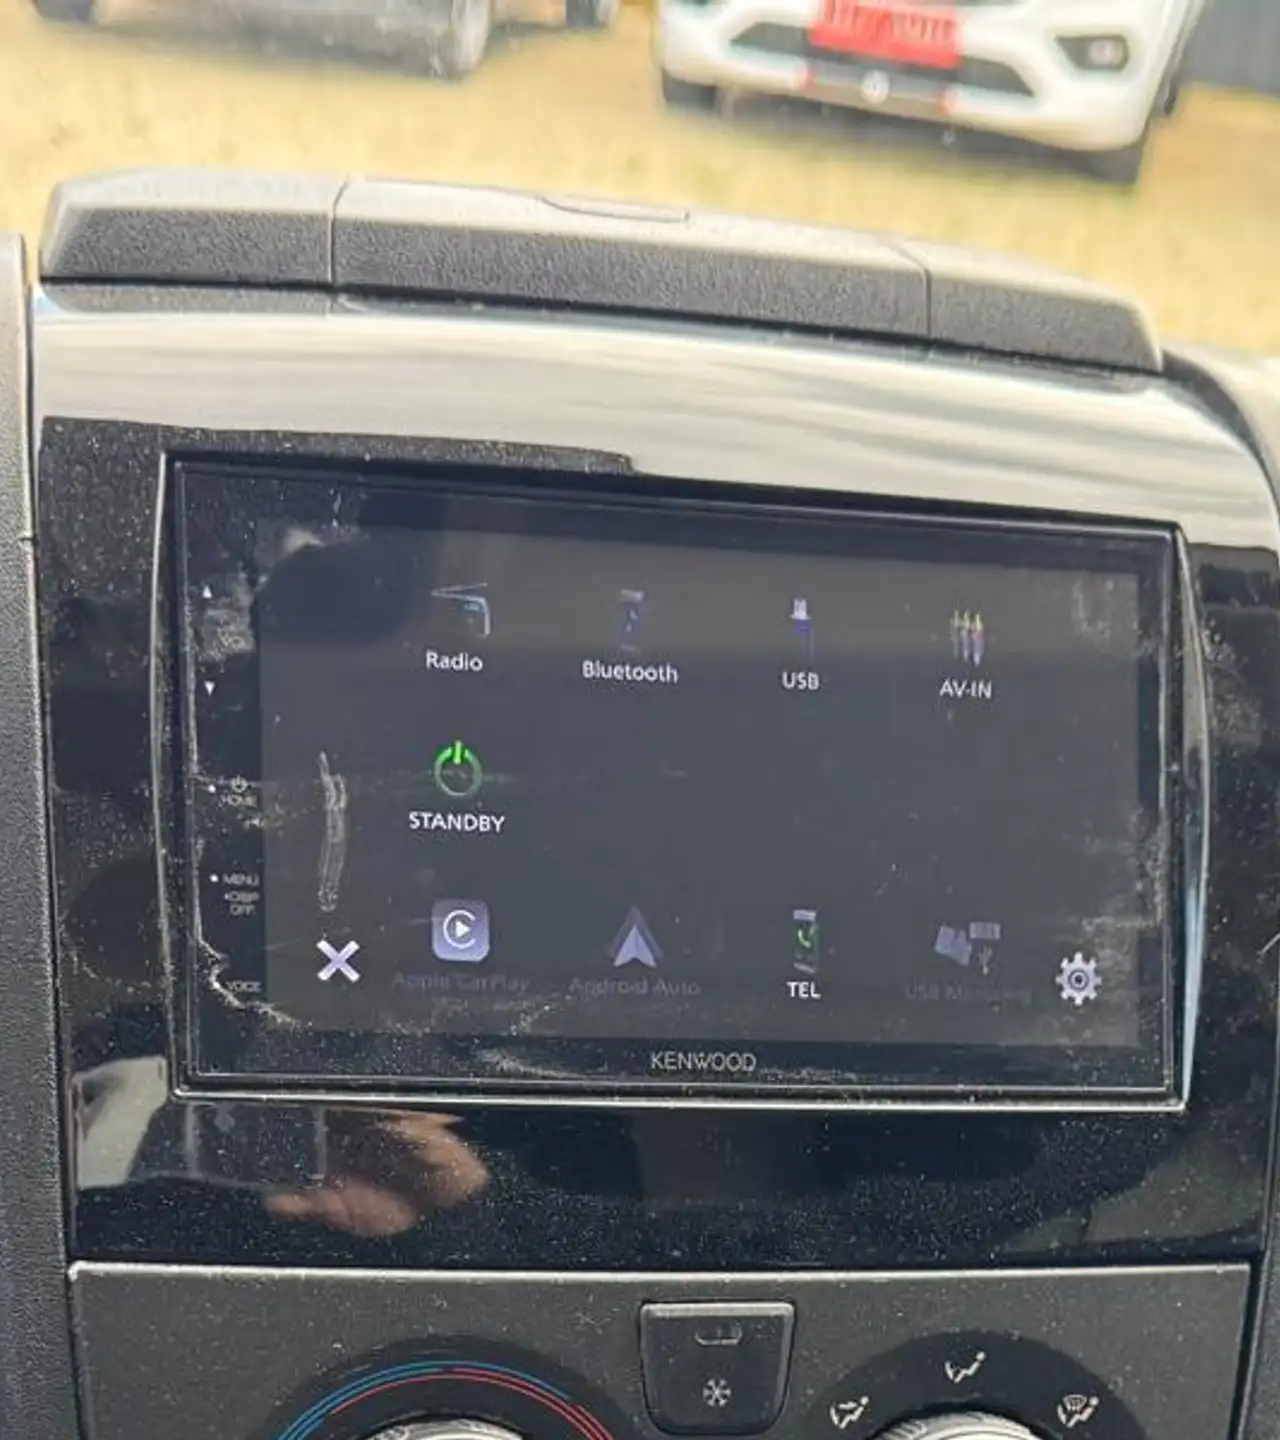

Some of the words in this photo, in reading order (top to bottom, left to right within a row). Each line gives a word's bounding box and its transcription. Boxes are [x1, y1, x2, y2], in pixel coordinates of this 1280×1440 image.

[425, 651, 484, 672] Radio
[582, 660, 678, 684] Bluetooth
[782, 671, 820, 691] USB
[939, 678, 993, 699] AV-IN
[408, 810, 506, 835] STANDBY
[223, 873, 260, 887] MENU
[225, 979, 261, 993] VOICE
[786, 981, 821, 1000] TEL
[650, 1050, 758, 1073] KENWOOD
